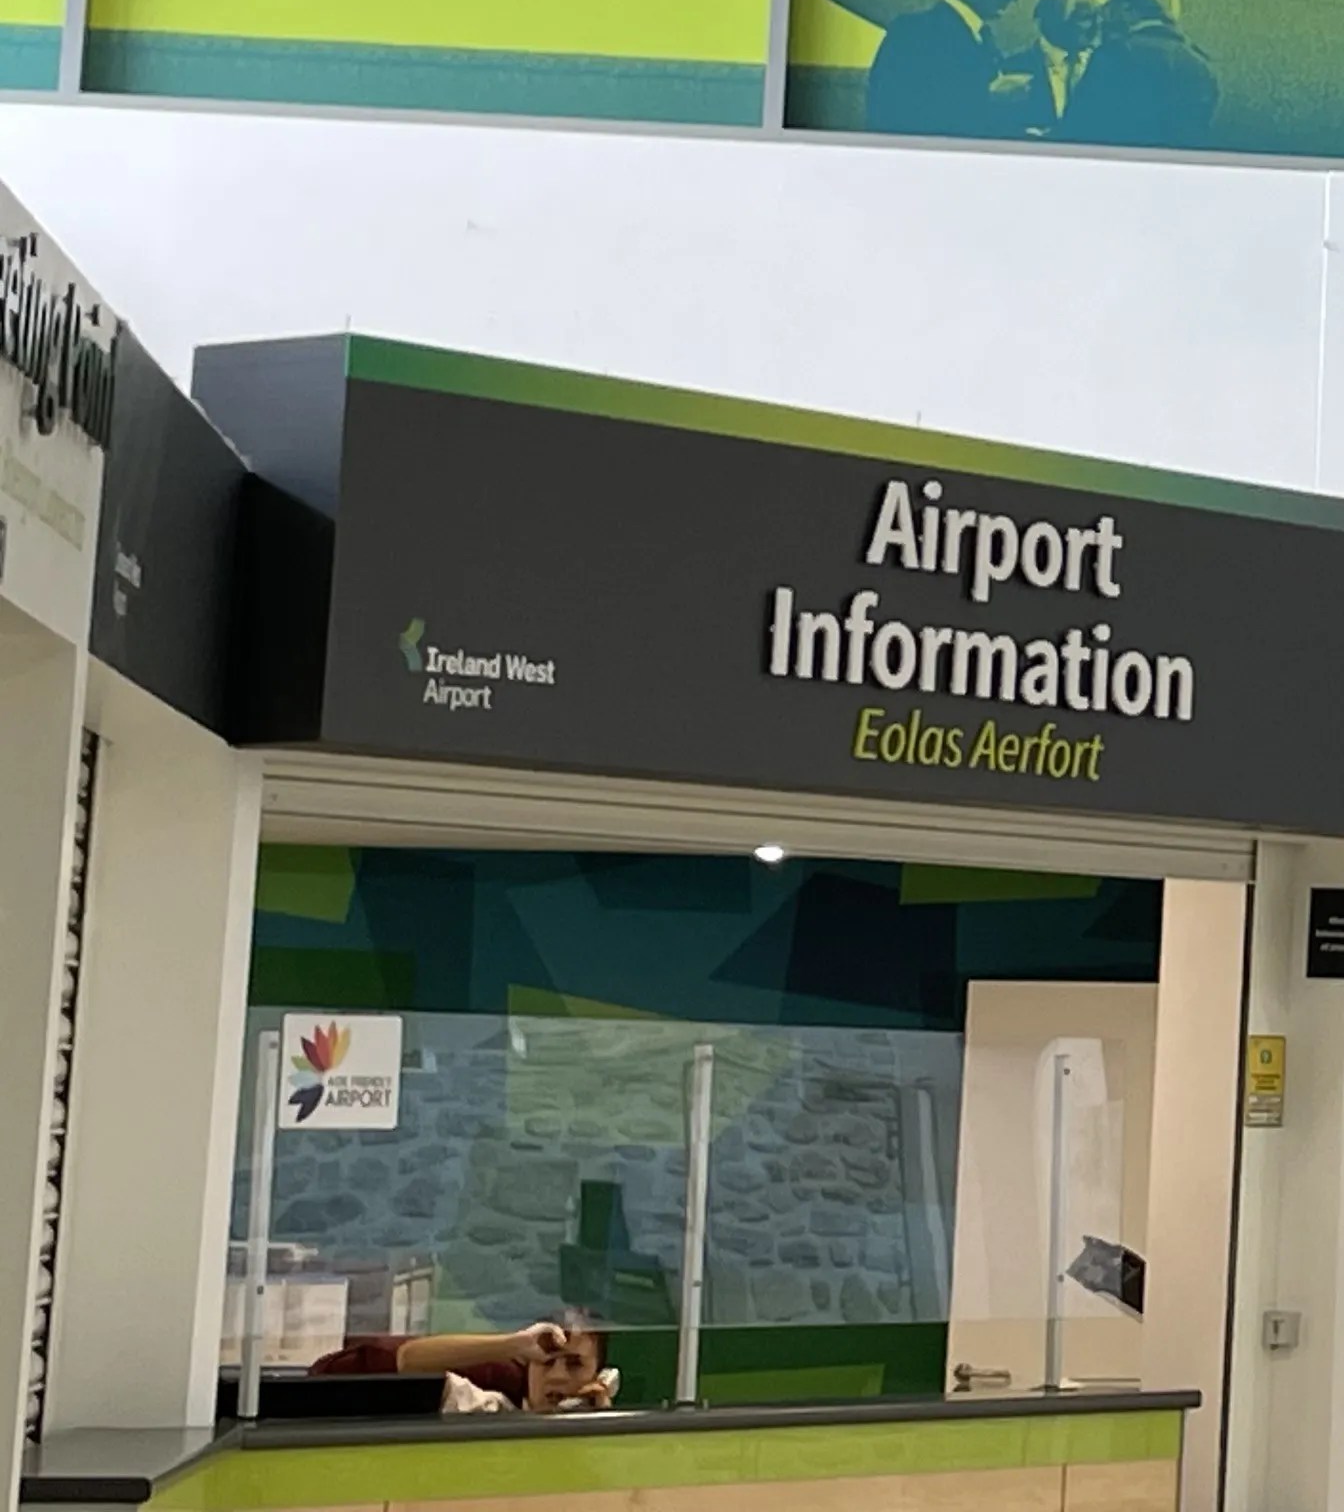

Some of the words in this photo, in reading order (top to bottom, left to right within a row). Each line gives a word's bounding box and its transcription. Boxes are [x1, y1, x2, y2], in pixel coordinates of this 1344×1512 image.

[864, 479, 1123, 602] Airport
[425, 645, 502, 680] Ireland
[505, 653, 556, 685] West
[768, 586, 1193, 721] Information
[423, 677, 493, 712] Airport
[853, 707, 964, 769] Eolas
[969, 720, 1104, 782] Aerfort
[325, 1088, 392, 1108] AIRPORT
